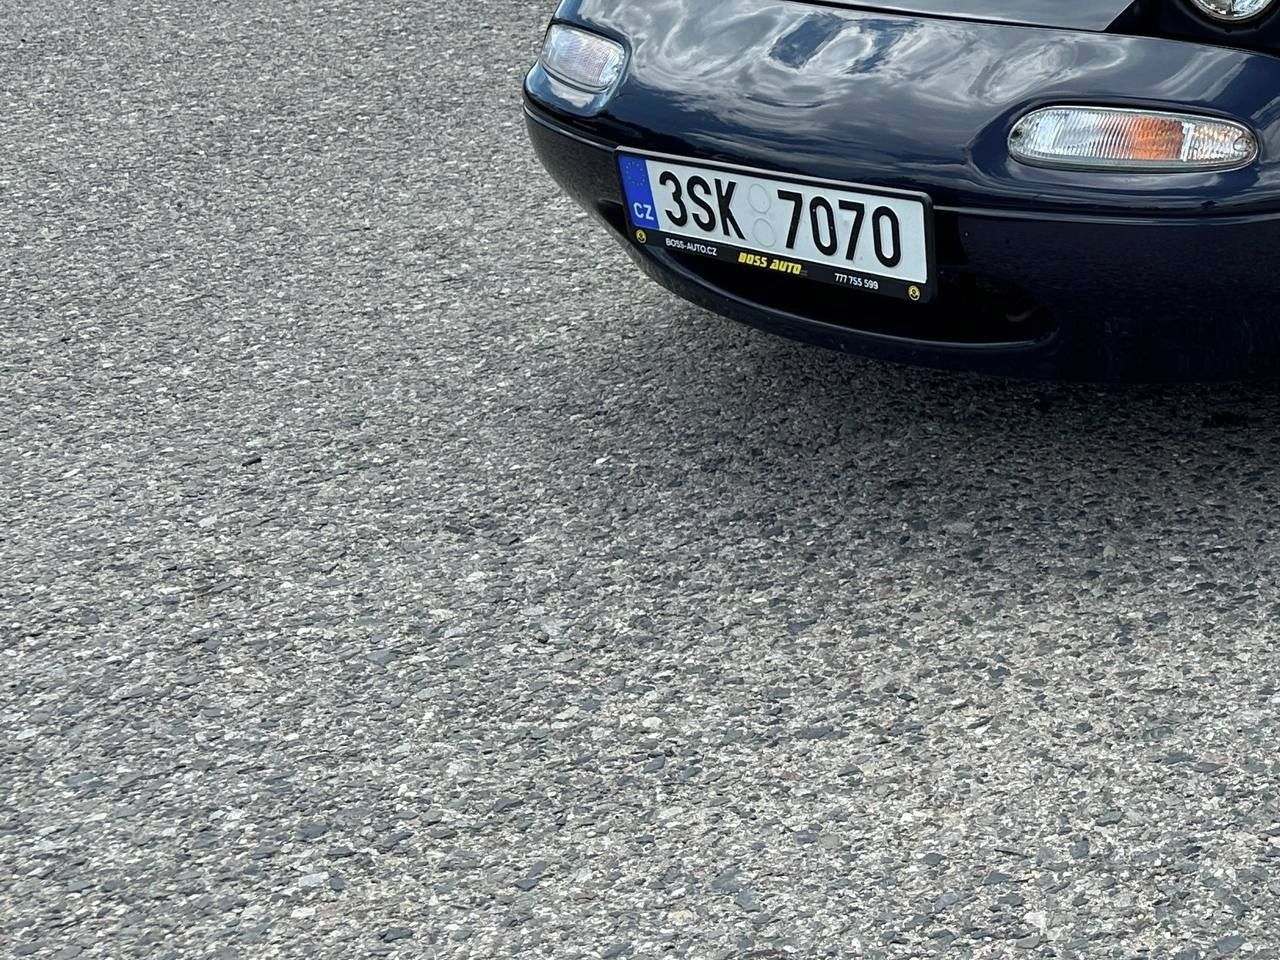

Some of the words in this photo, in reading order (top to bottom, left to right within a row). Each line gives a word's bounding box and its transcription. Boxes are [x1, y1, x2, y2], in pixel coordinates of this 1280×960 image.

[633, 201, 655, 220] CZ
[659, 170, 746, 240] 3SK
[777, 189, 900, 268] 7070
[665, 237, 718, 257] BOSS-AUTO.CZ
[738, 251, 768, 268] BOSS
[770, 259, 801, 276] AUTO
[834, 272, 848, 284] 777
[848, 275, 863, 288] 755
[864, 278, 879, 290] 599
